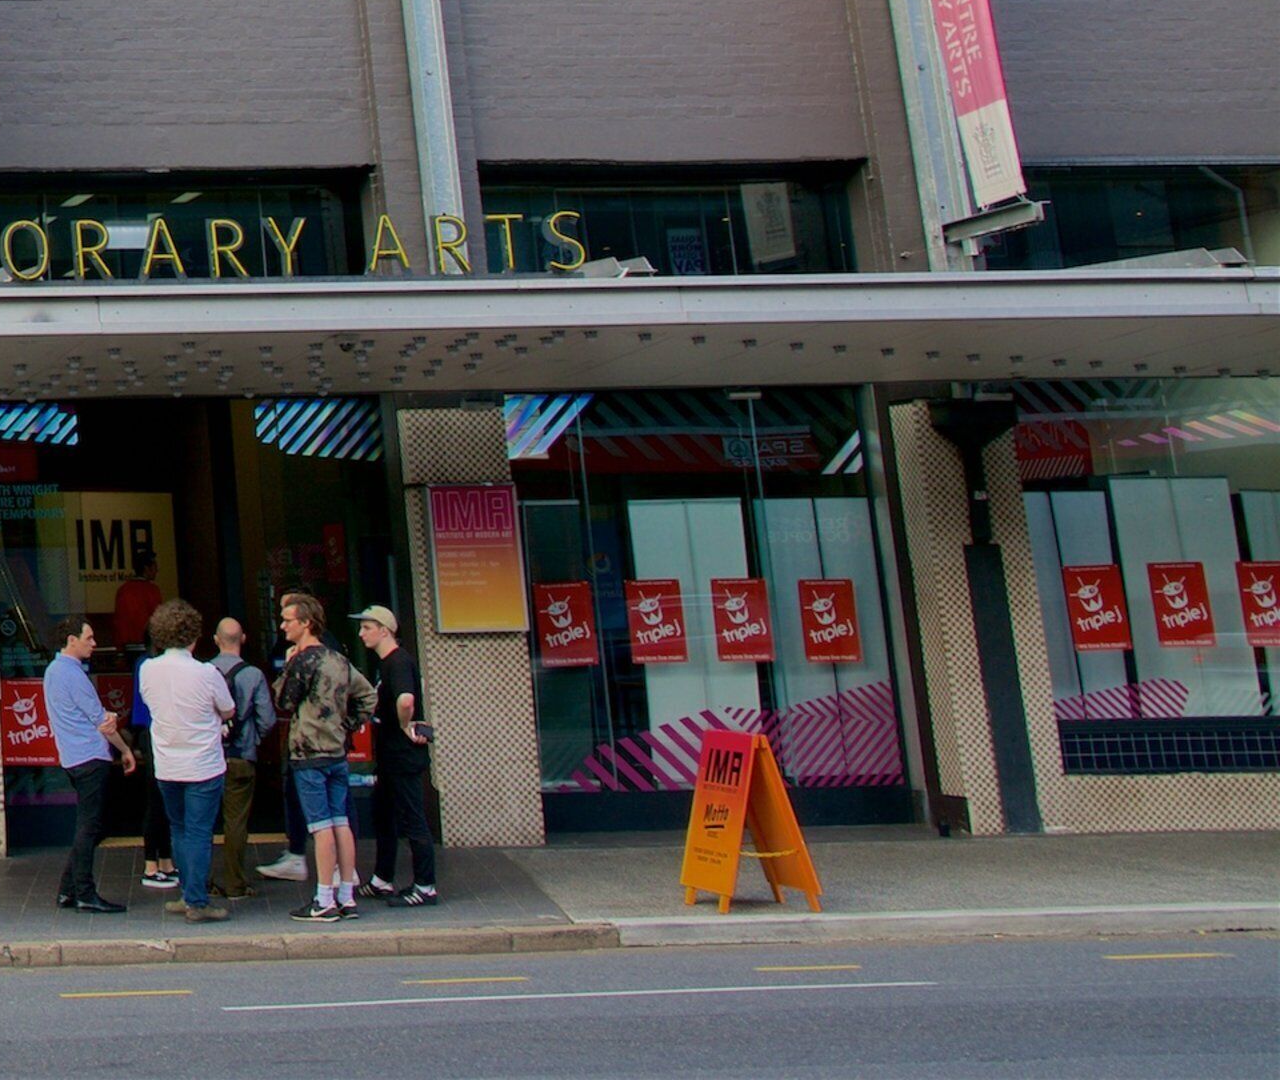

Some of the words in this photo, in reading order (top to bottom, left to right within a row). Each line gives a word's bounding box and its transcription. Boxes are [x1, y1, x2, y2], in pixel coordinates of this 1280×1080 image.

[938, 21, 972, 99] ARTS
[368, 210, 587, 274] ARTS
[432, 490, 513, 531] IMA
[75, 519, 154, 571] IMA
[1077, 610, 1115, 632] triple
[1115, 605, 1123, 623] j
[1161, 607, 1201, 629] triple
[1200, 602, 1208, 620] j
[545, 626, 584, 648] triple
[583, 621, 591, 638] j
[636, 623, 675, 644] triple
[674, 619, 681, 636] j
[722, 622, 760, 643] triple
[760, 618, 767, 635] j
[810, 623, 847, 644] triple
[847, 619, 854, 636] j
[7, 724, 48, 745] triple
[704, 748, 743, 787] IMA
